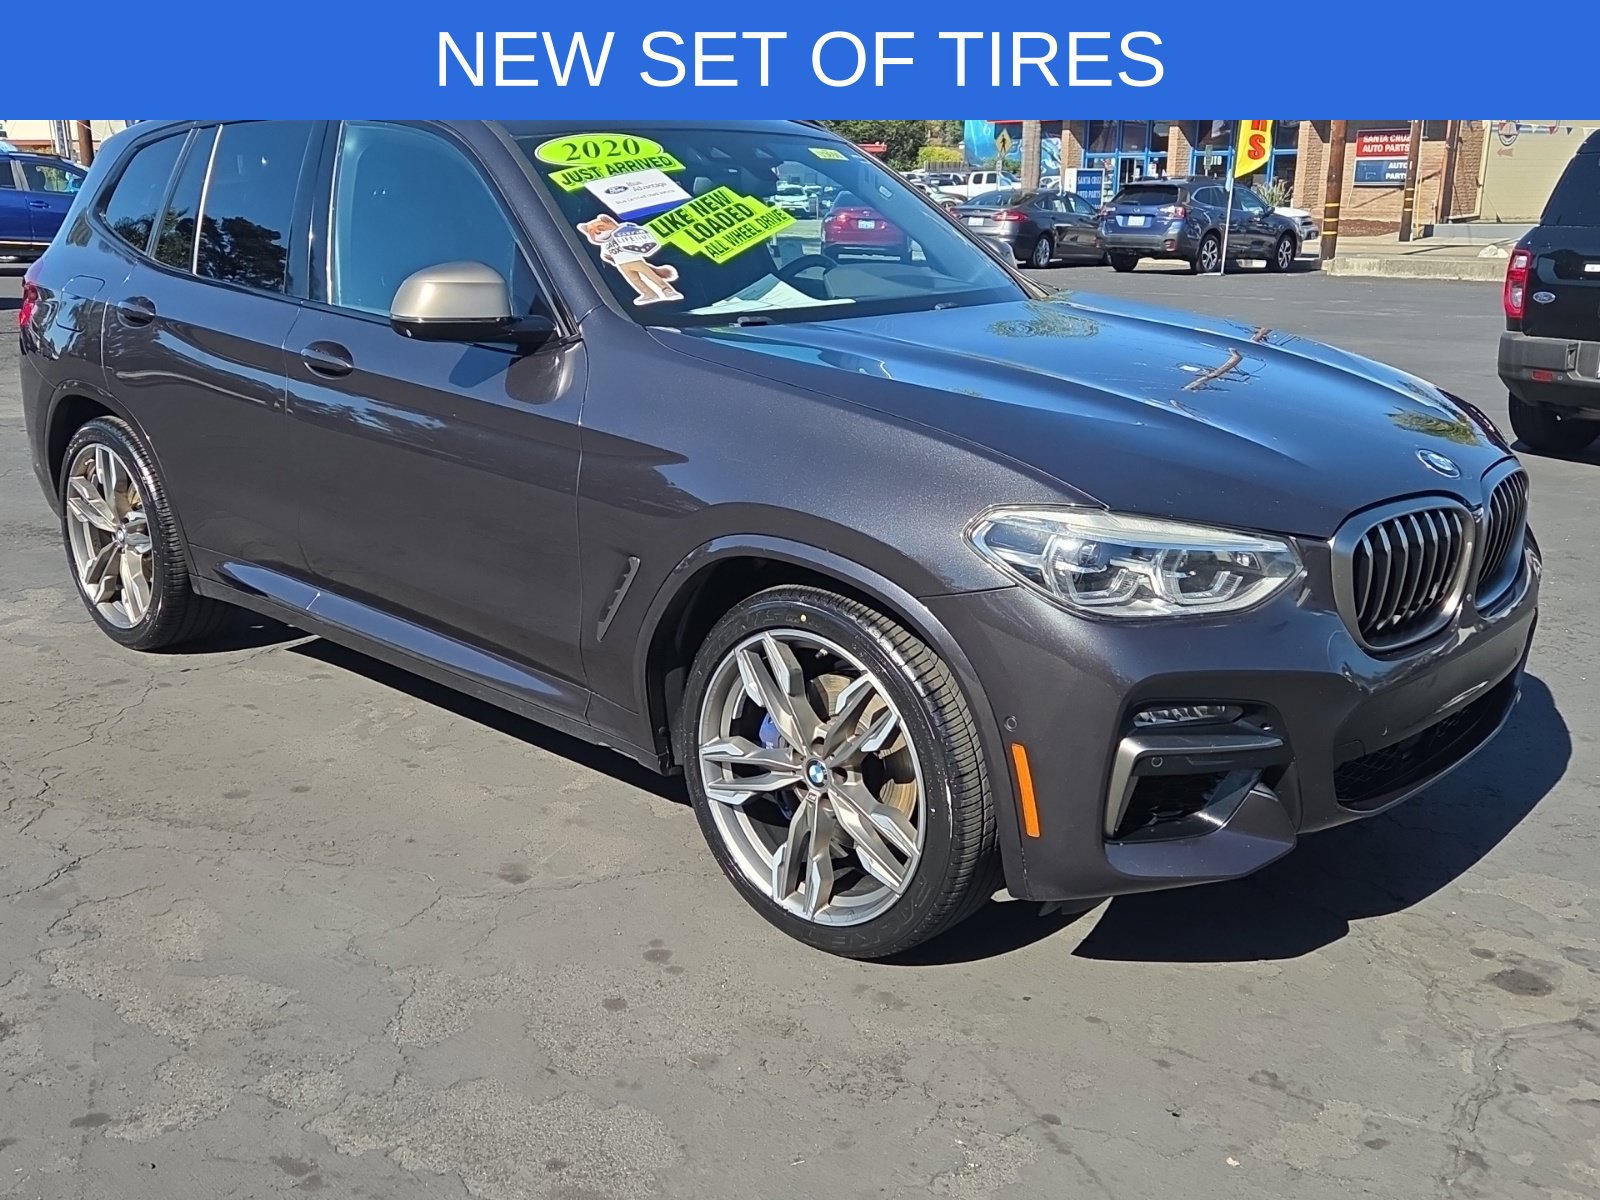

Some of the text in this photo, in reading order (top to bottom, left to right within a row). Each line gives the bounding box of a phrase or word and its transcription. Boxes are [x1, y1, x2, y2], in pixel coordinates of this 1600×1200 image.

[561, 137, 641, 161] 2020
[1362, 144, 1409, 152] AUTO PARTS
[1363, 134, 1388, 143] SANTA
[561, 155, 674, 186] JUST ARRIVED
[649, 190, 733, 238] LIKE NEW
[684, 202, 755, 244] LOADED
[705, 208, 788, 258] ALL WHEEL DRIVE
